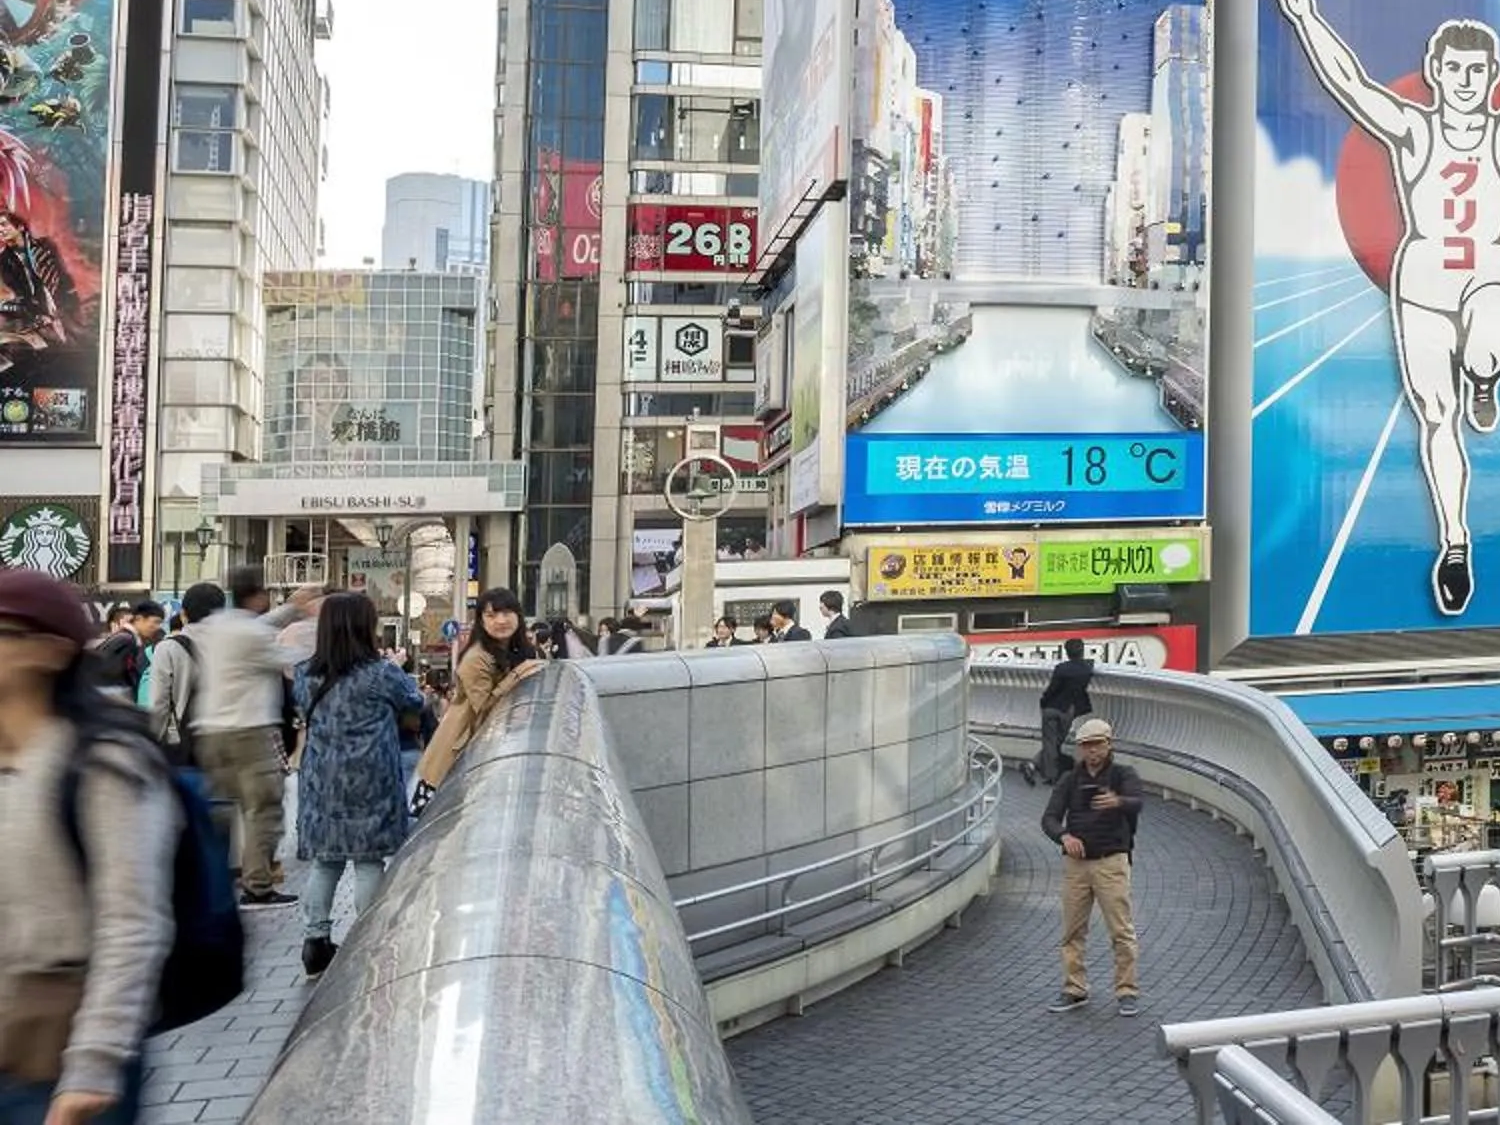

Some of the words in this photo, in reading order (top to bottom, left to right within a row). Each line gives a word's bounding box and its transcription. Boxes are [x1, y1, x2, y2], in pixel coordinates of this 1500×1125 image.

[1440, 155, 1482, 271] グリコ
[896, 454, 1031, 481] 現在の気温
[1061, 445, 1108, 486] 18
[983, 499, 1067, 515] 雪印メグミルク
